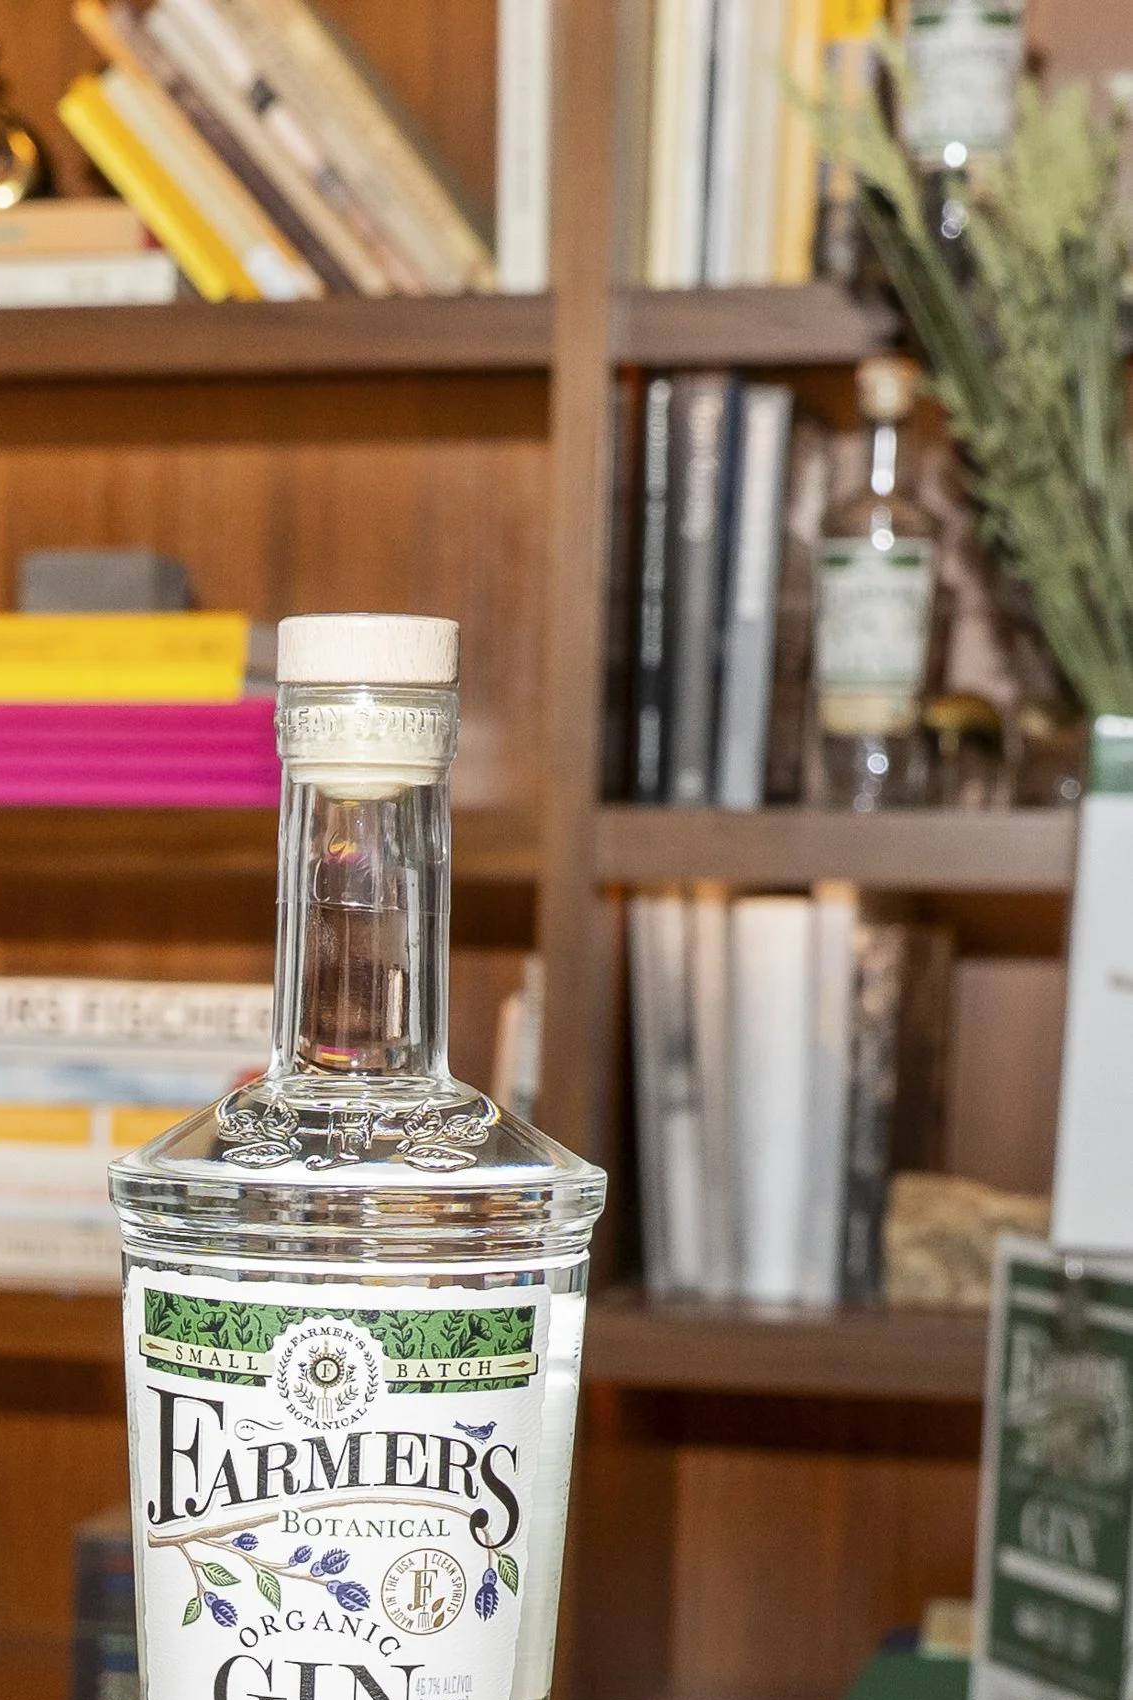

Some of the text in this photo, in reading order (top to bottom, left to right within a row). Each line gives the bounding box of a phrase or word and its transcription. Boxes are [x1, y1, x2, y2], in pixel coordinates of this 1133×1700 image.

[290, 1326, 366, 1350] FARMER'S
[175, 1345, 493, 1378] SMALL BATCH
[286, 1403, 367, 1430] BOTANICAL
[147, 1385, 520, 1549] FARMERS
[281, 1509, 451, 1538] BOTANICAL
[395, 1557, 415, 1575] USA
[385, 1575, 400, 1592] THE
[431, 1553, 463, 1614] CLEAN SPIRITS
[390, 1607, 414, 1630] MADE
[239, 1610, 401, 1658] ORGANIC
